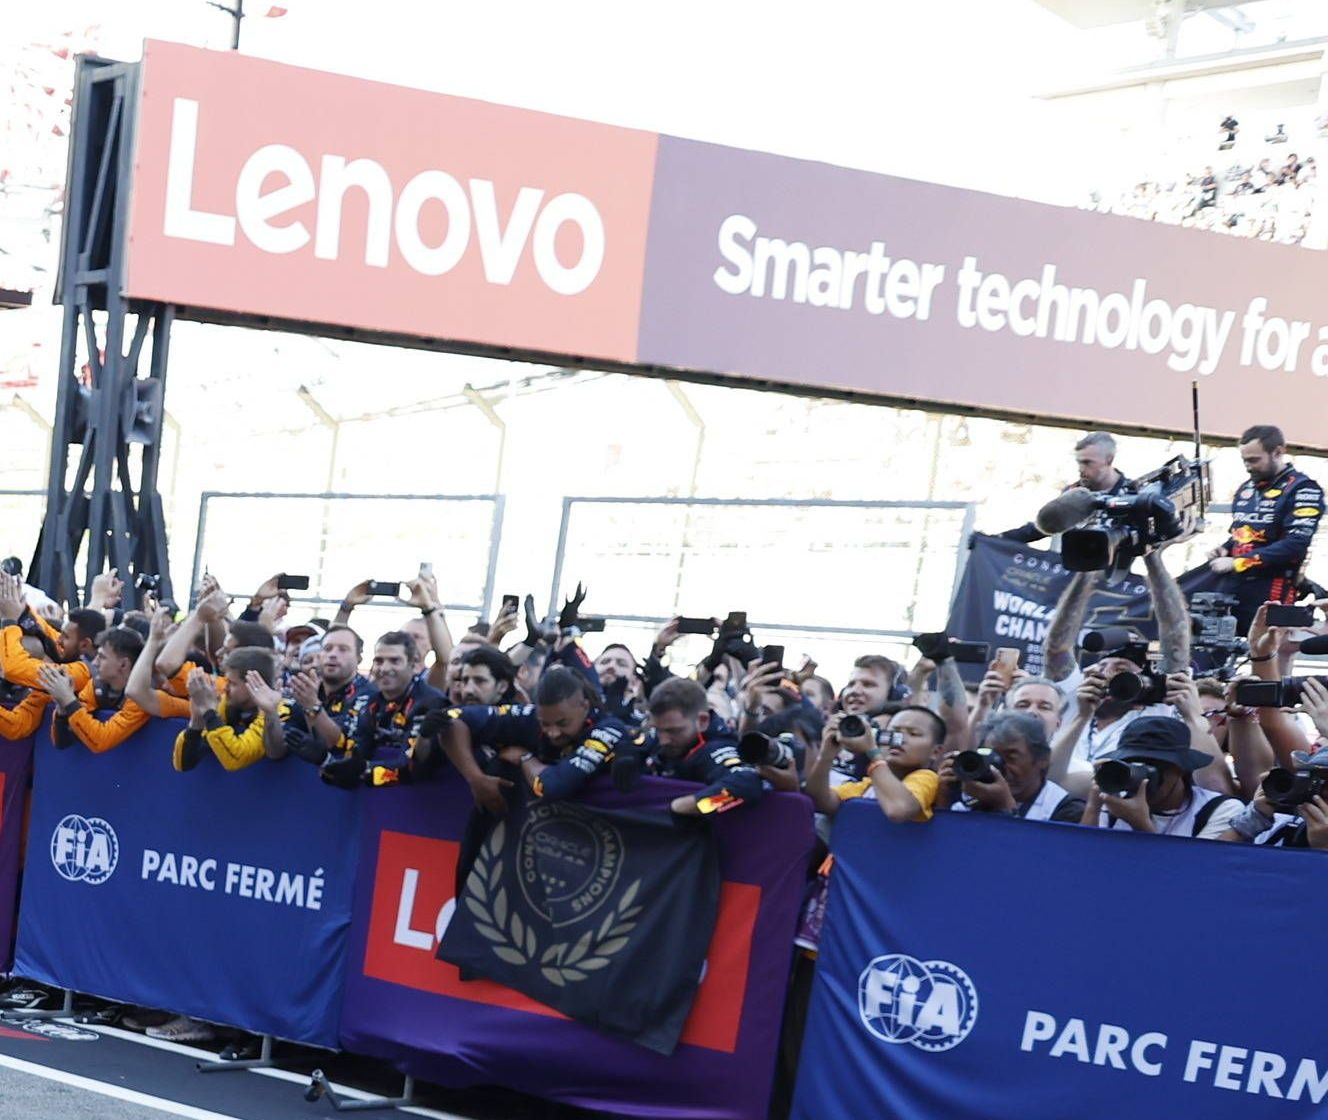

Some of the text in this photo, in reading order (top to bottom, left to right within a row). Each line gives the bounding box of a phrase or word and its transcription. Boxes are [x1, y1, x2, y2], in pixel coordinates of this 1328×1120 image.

[162, 98, 604, 294] Lenovo
[713, 214, 944, 321] Smarter
[957, 257, 1236, 375] technology
[1240, 297, 1310, 372] for
[141, 849, 324, 910] PARC FERMÉ
[1020, 1010, 1328, 1104] PARC FERM
